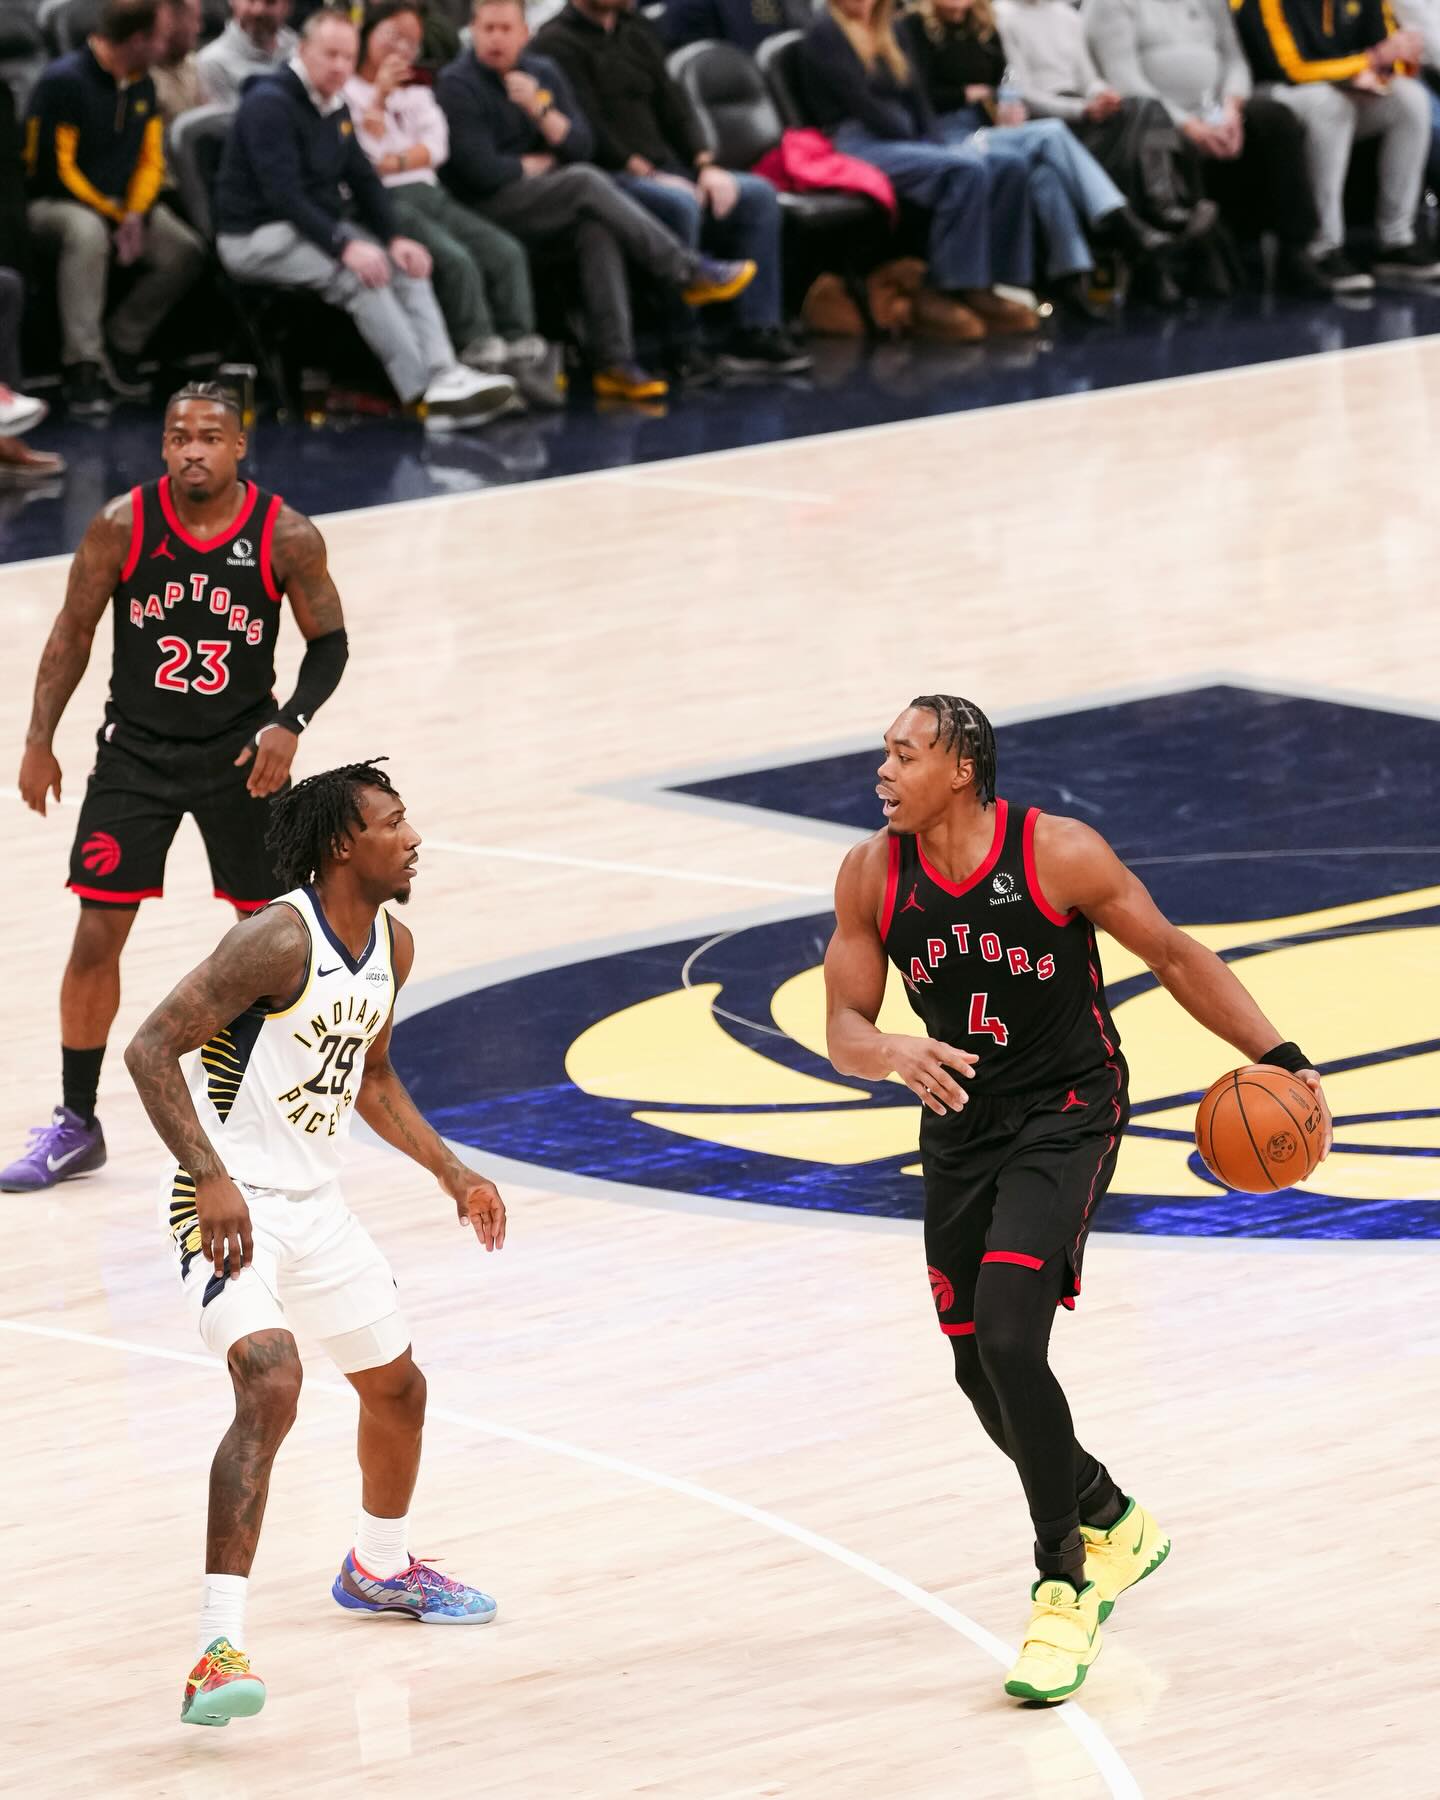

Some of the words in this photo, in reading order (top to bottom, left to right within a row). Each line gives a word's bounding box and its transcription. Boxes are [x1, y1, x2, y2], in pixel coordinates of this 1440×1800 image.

[130, 573, 264, 645] RAPTORS
[155, 635, 231, 695] 23
[989, 897, 1006, 906] Sun
[1006, 892, 1023, 903] Life
[900, 923, 1055, 994] APTORS
[968, 992, 1009, 1046] 4
[302, 1035, 364, 1095] 29
